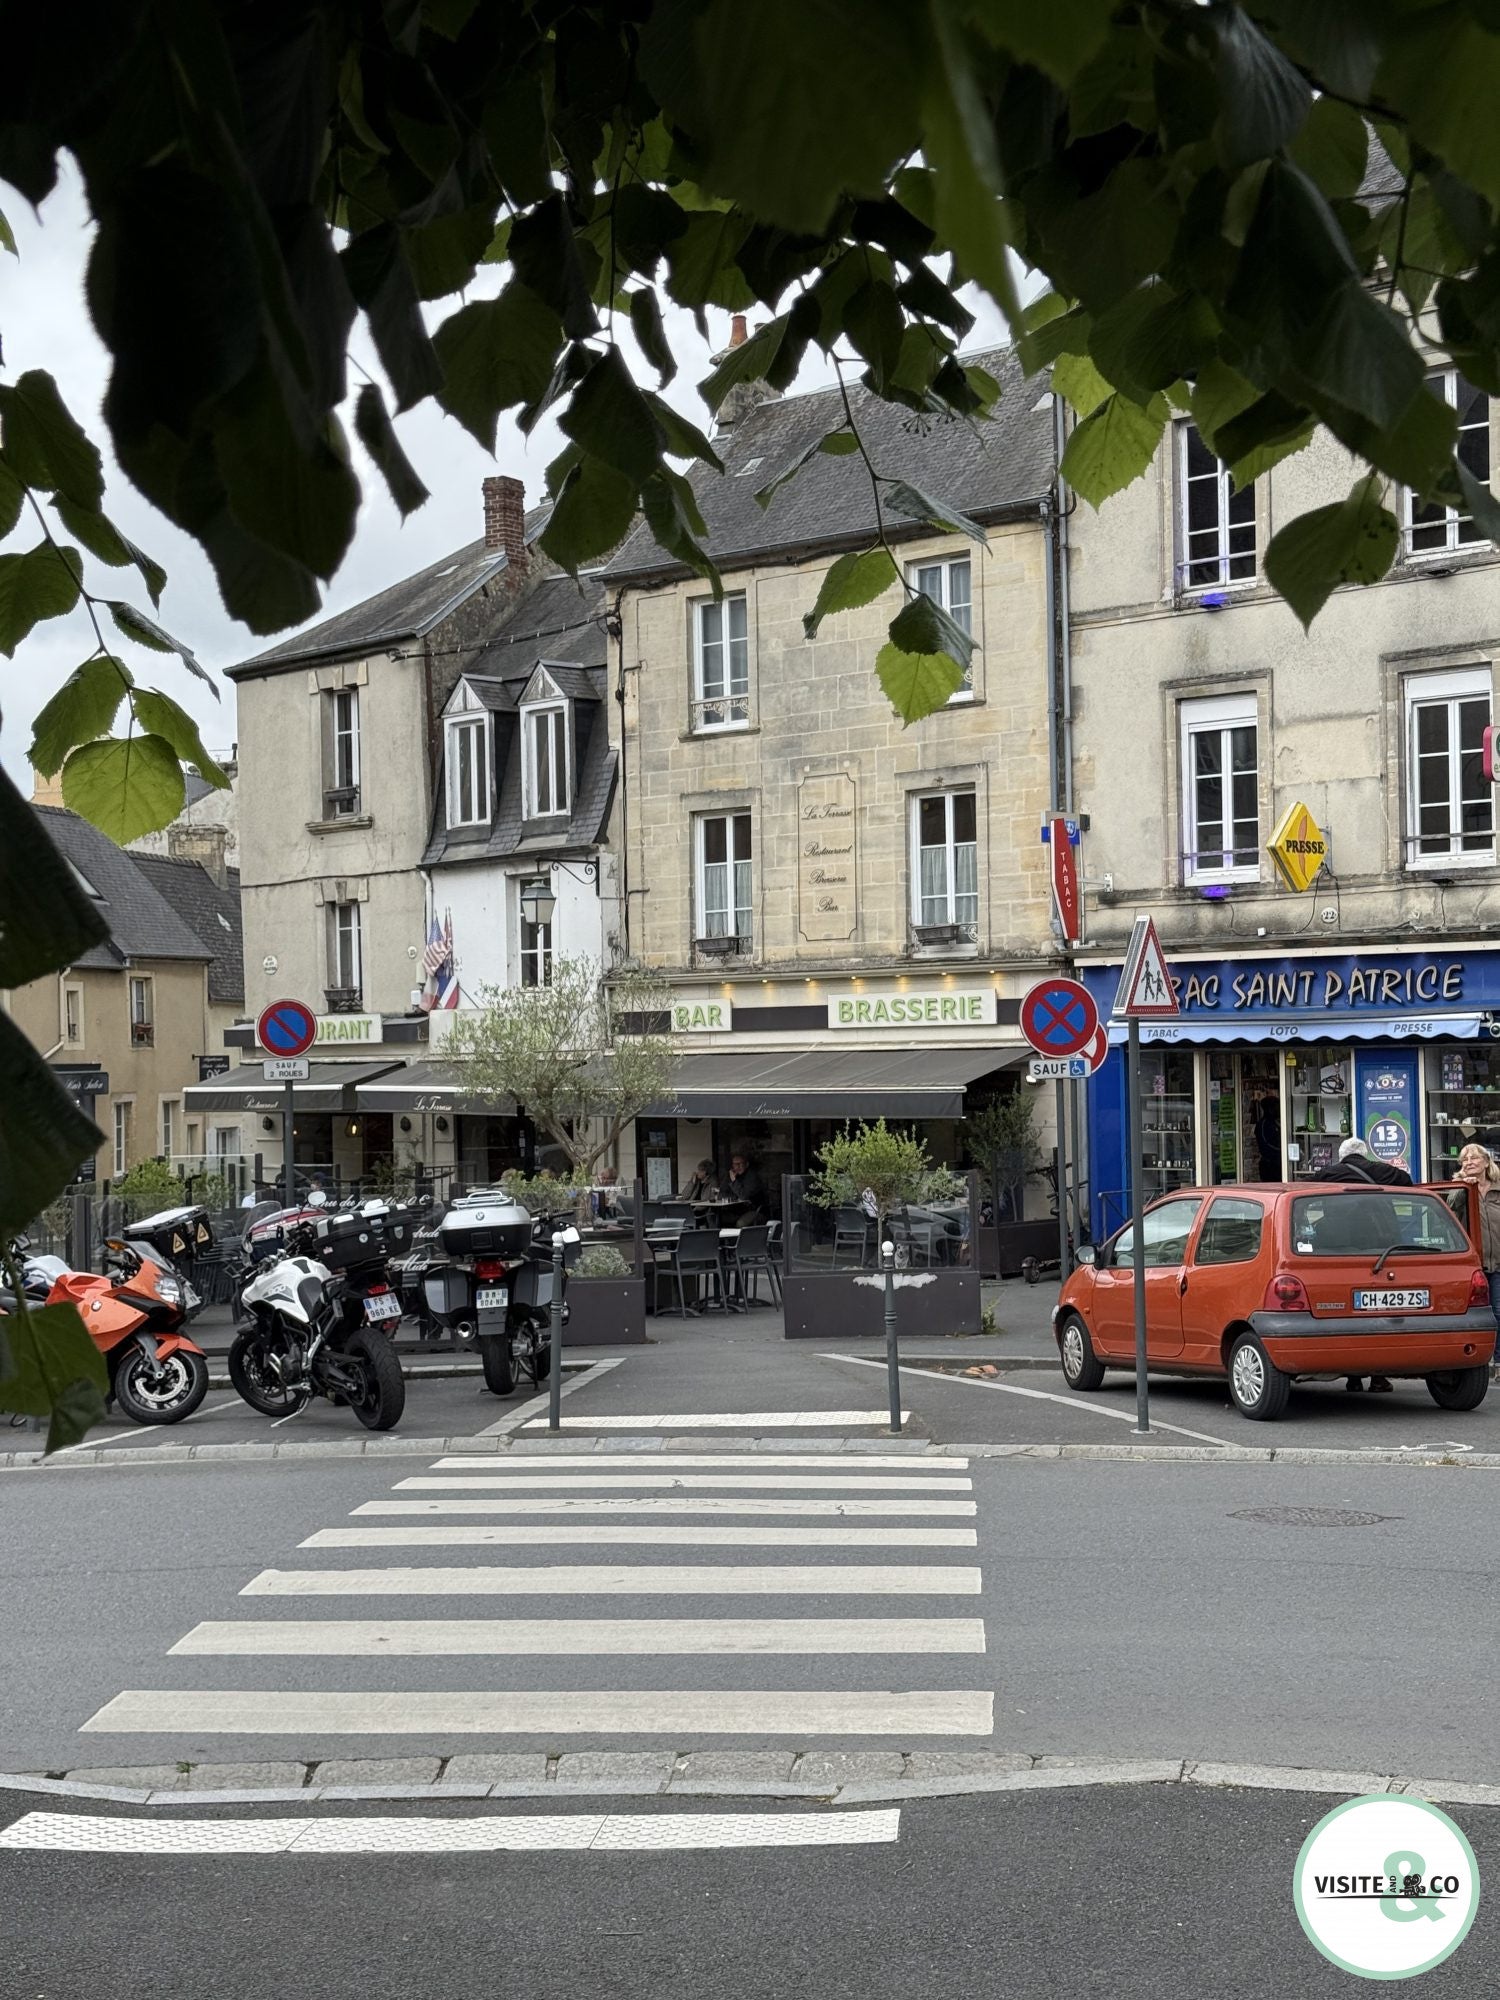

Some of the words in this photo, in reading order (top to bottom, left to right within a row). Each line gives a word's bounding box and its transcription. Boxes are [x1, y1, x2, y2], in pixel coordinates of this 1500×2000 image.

[802, 805, 817, 820] La
[803, 841, 853, 857] Restaurant
[1286, 840, 1325, 854] PRESSE
[1060, 852, 1072, 907] TABAC
[817, 896, 839, 912] Bar
[1323, 911, 1337, 919] 22
[1170, 973, 1219, 1010] BAC
[1233, 970, 1315, 1008] SAINT
[1324, 963, 1463, 1006] PATRICE
[676, 1004, 722, 1028] BAR
[838, 996, 983, 1023] BRASSERIE
[1147, 1029, 1179, 1038] TABAC
[1270, 1026, 1299, 1036] LOTO
[1393, 1023, 1434, 1033] PRESSE
[1033, 1063, 1067, 1075] SAUF
[1376, 1125, 1398, 1141] 13
[1362, 1292, 1423, 1307] CH-429-ZS
